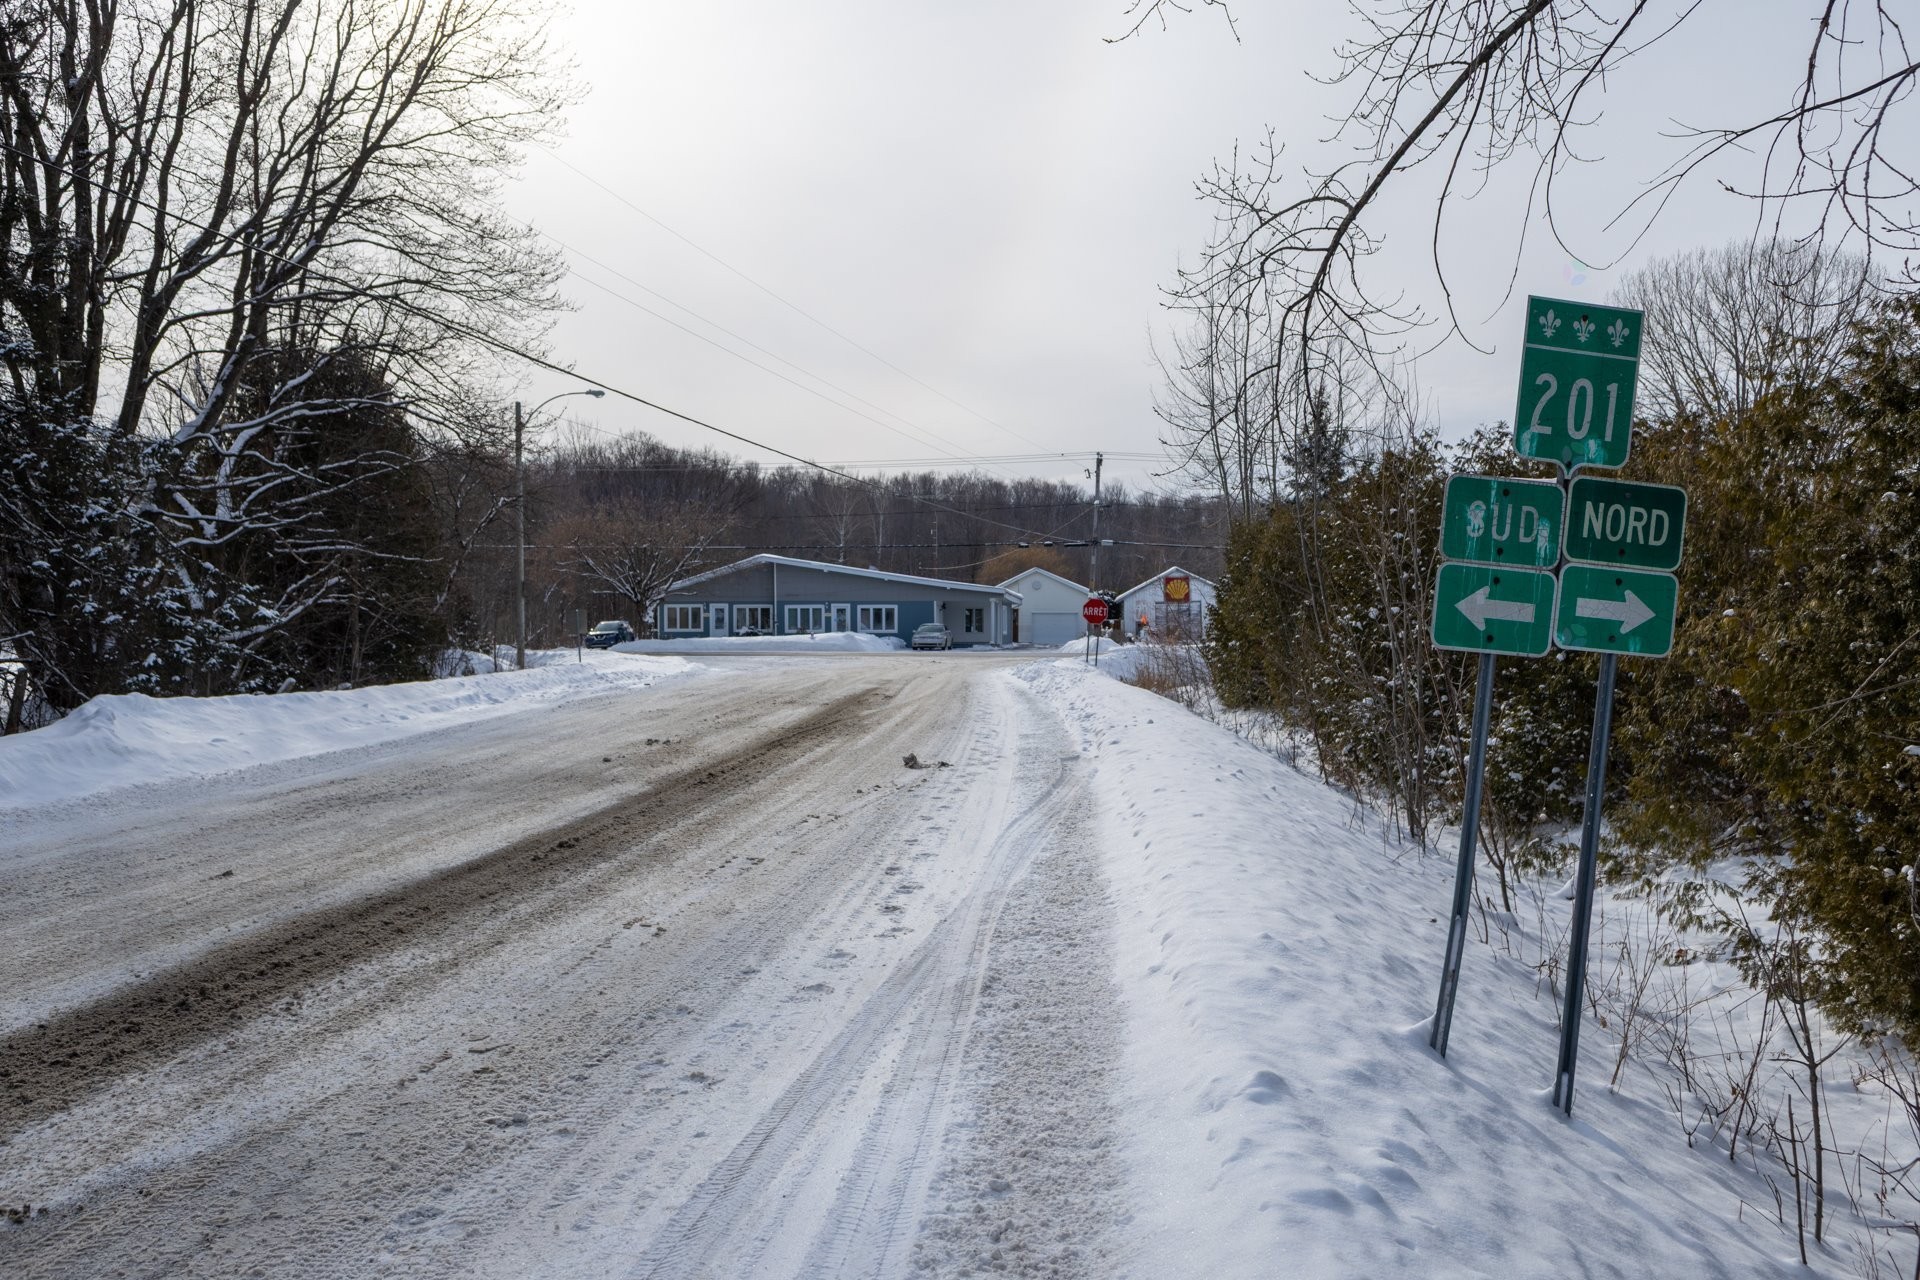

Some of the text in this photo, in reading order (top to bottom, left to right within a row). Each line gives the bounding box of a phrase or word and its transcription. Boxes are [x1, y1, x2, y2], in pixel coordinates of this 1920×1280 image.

[1529, 372, 1618, 442] 201
[1467, 500, 1539, 543] SUD
[1582, 501, 1669, 546] NORD
[1084, 606, 1107, 616] ARRÊT
